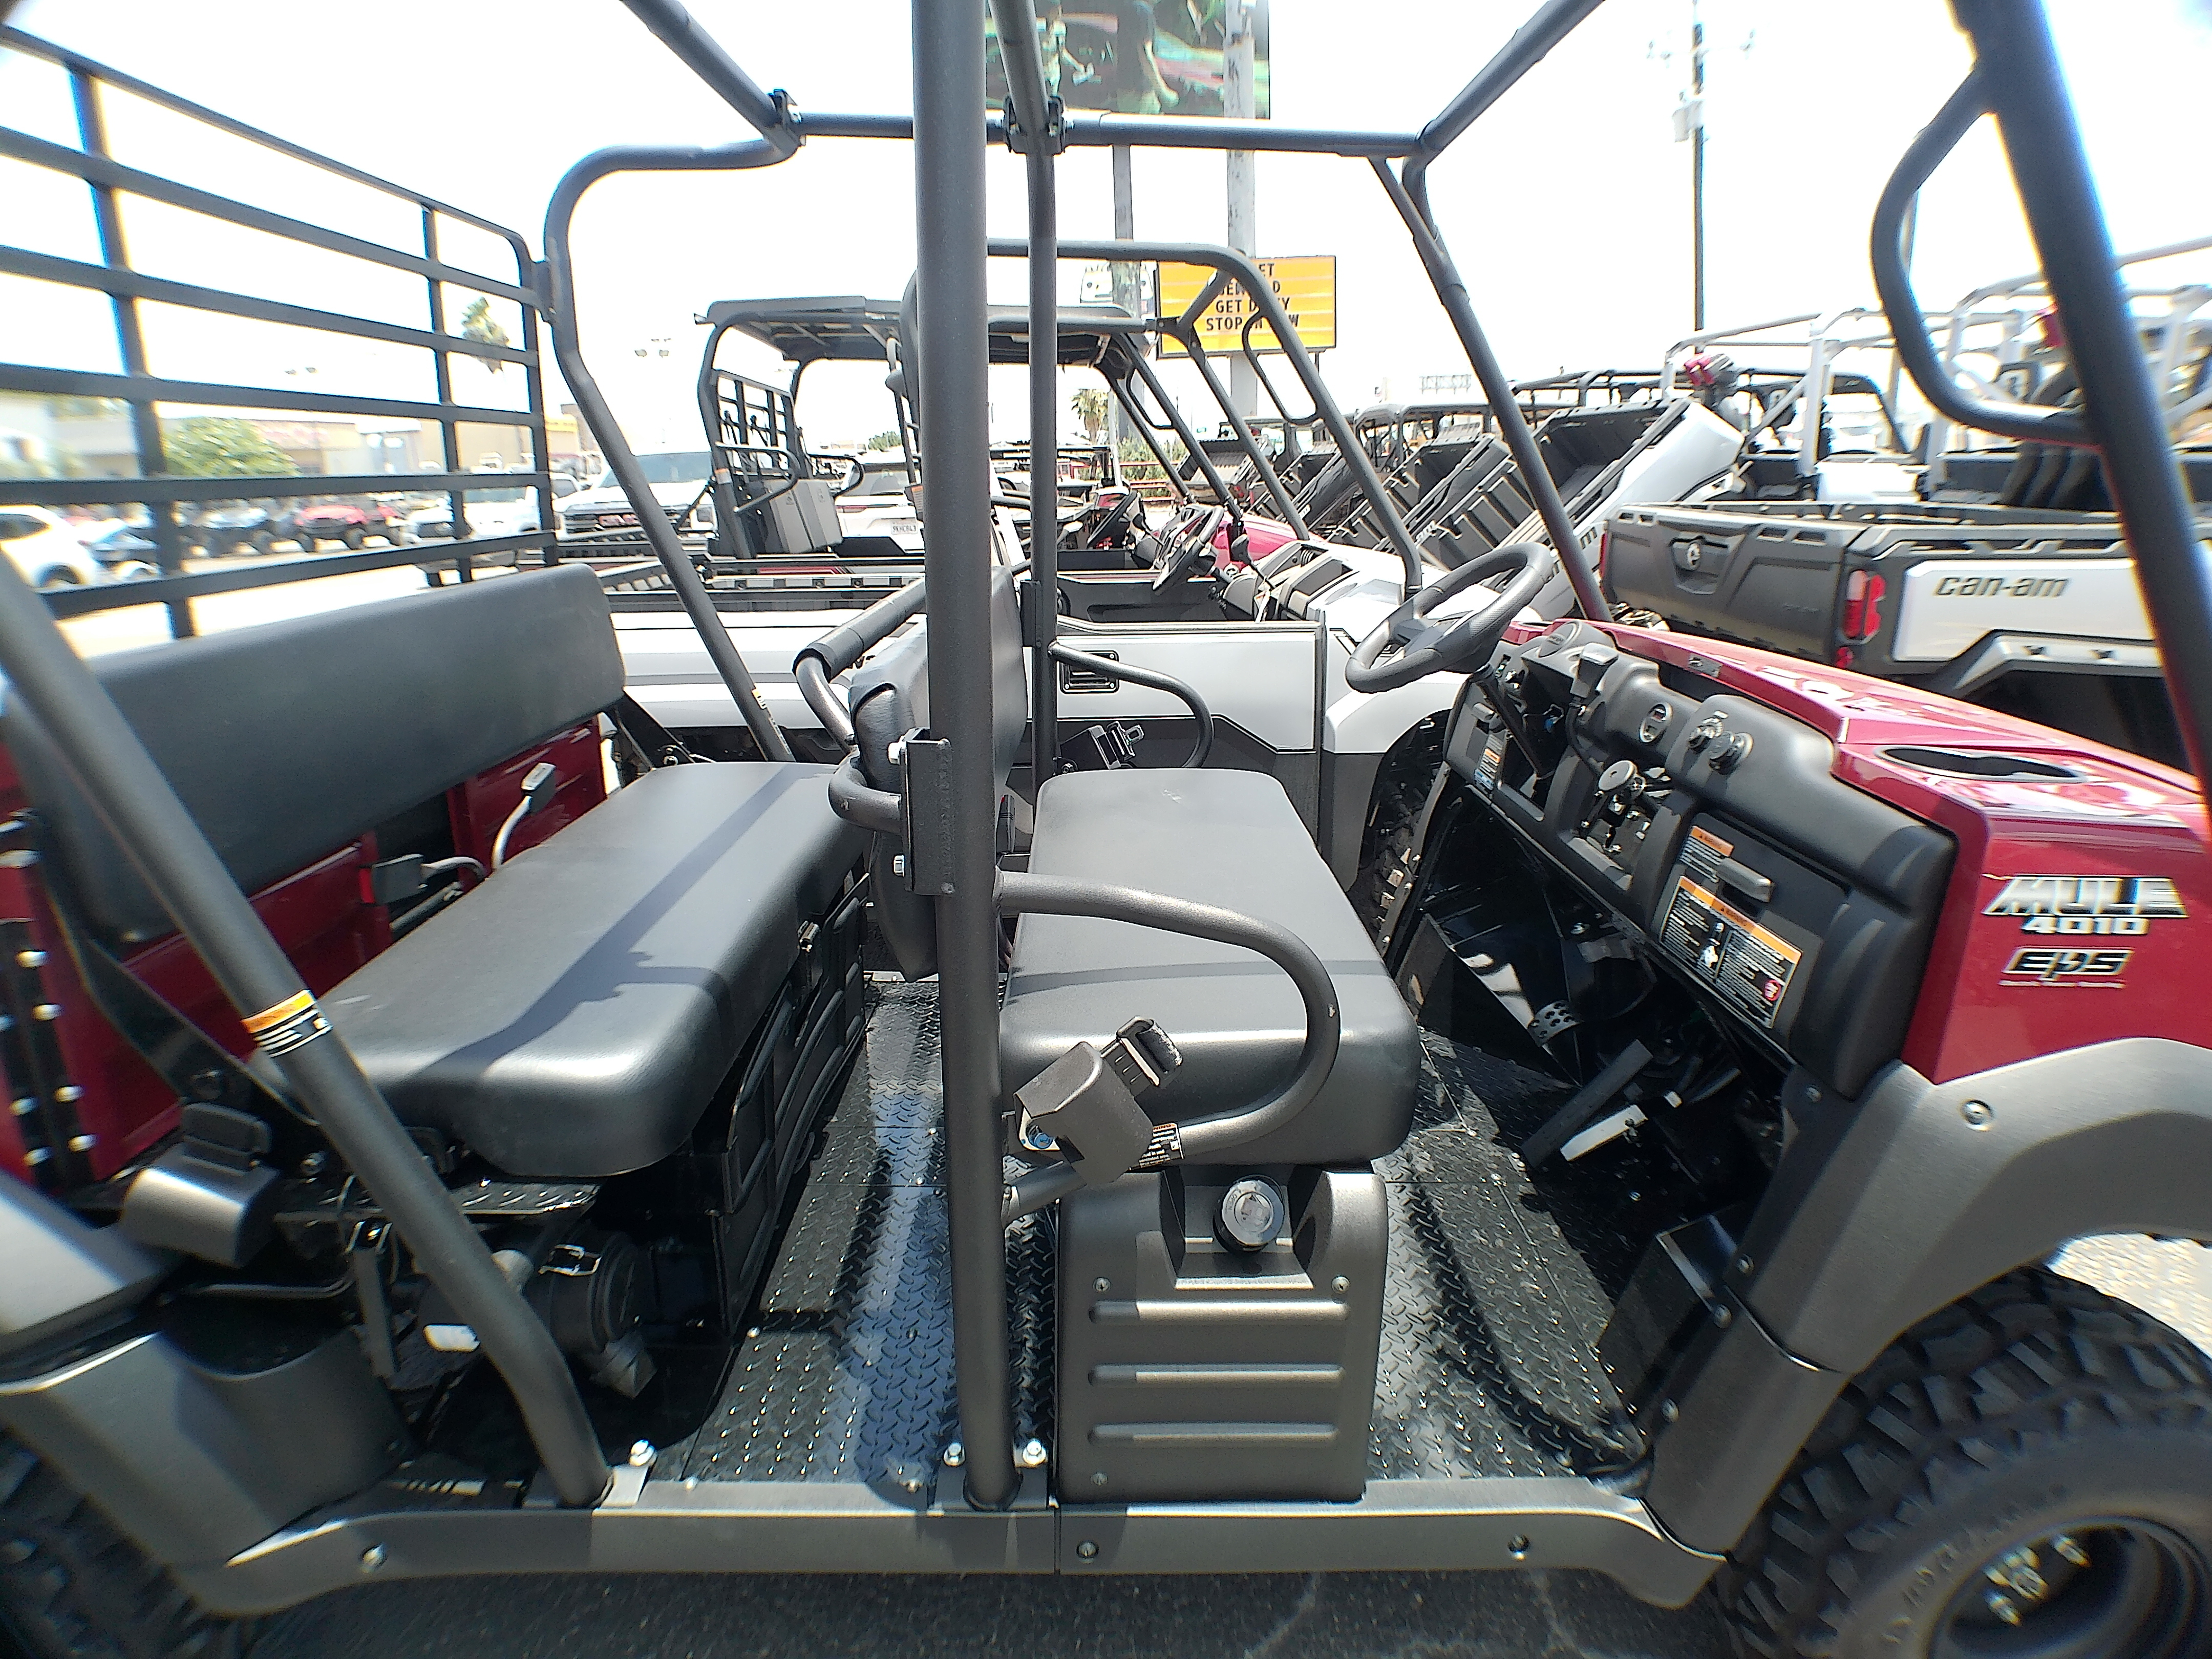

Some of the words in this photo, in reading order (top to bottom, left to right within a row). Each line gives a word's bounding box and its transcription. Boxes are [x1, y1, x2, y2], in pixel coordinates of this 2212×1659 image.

[1216, 300, 1242, 313] GET
[1206, 316, 1243, 331] STOP
[1933, 576, 2071, 598] can-am
[1981, 874, 2190, 918] MULE
[2020, 916, 2150, 935] 4010
